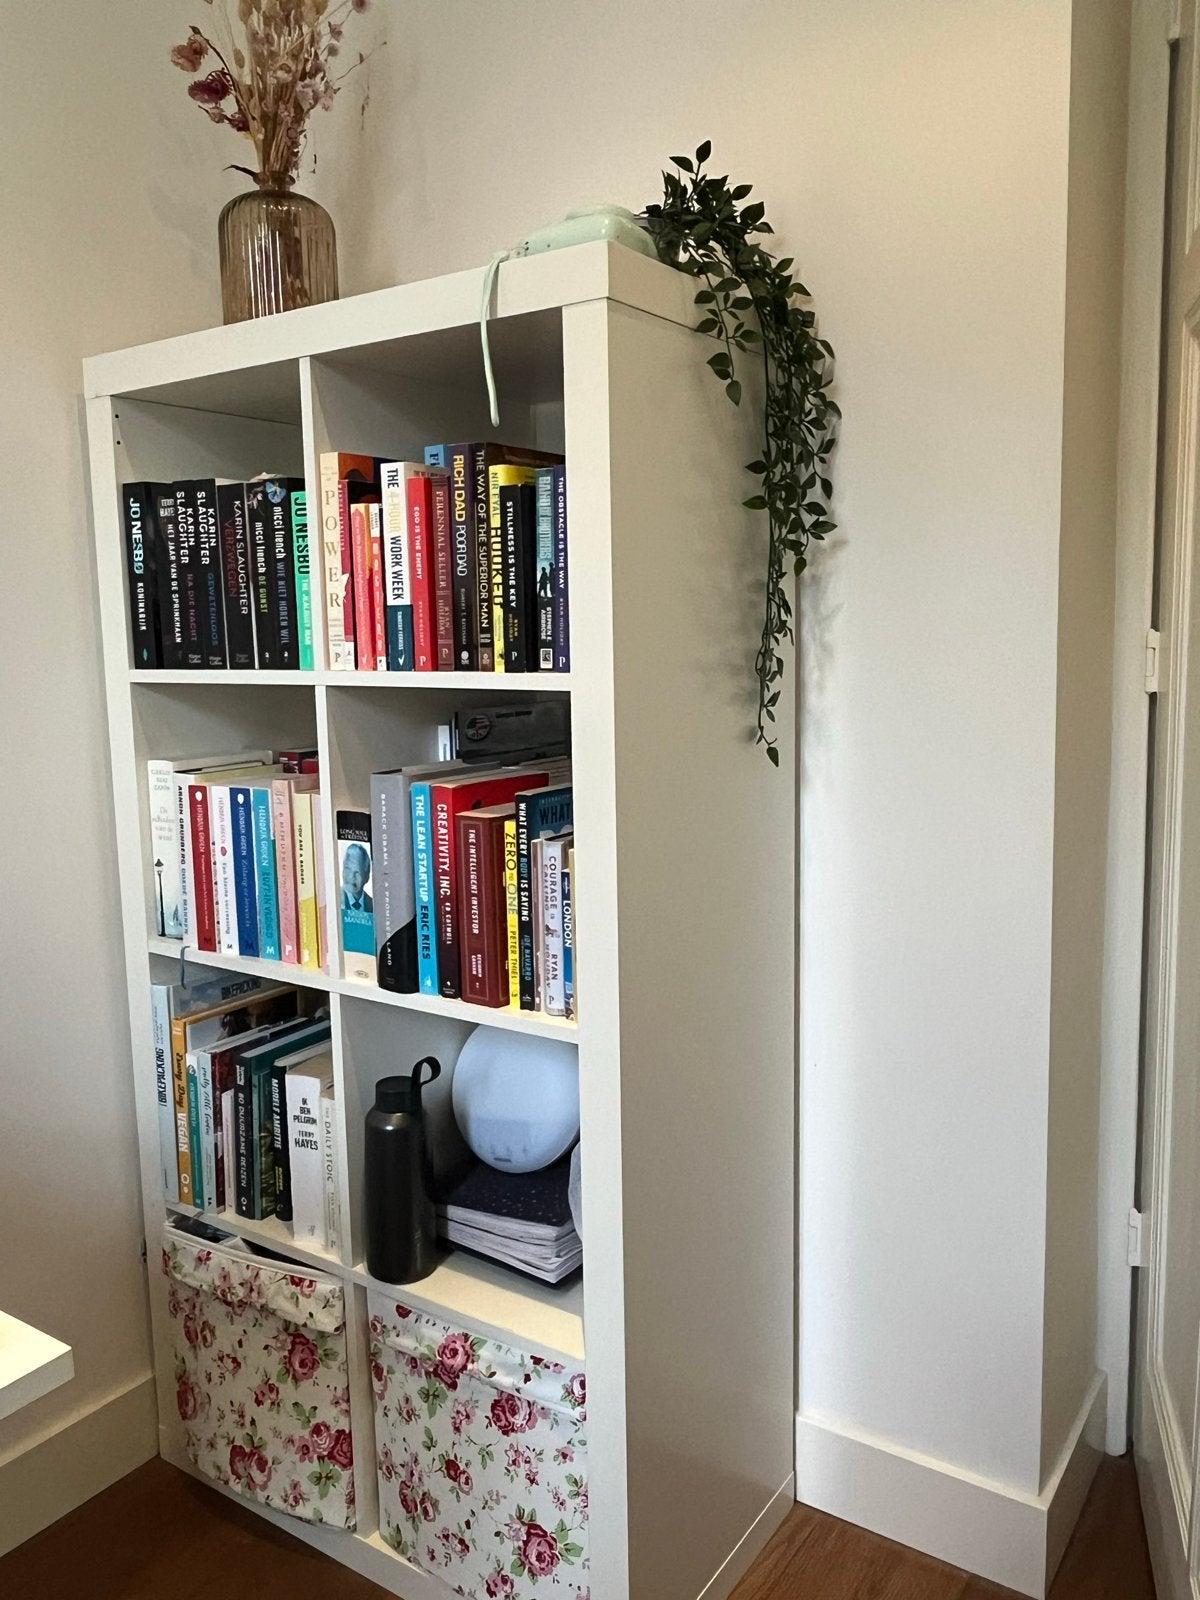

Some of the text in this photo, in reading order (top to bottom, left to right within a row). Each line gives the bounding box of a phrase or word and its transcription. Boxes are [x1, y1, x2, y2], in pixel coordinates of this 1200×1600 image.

[476, 450, 485, 471] THE
[387, 468, 399, 489] THE
[477, 473, 487, 501] WAY
[491, 472, 500, 489] NIR
[538, 477, 552, 506] BAND
[129, 497, 141, 519] JO
[273, 506, 284, 529] nicci
[413, 506, 421, 524] EGO
[453, 455, 468, 577] RICH DAD POOR DAD
[478, 502, 487, 519] OF
[176, 491, 190, 564] SLAUGHTER
[186, 508, 196, 546] KARIN
[197, 491, 210, 565] SLAUGHTER
[207, 508, 217, 547] KARIN
[255, 521, 265, 544] nicci
[415, 525, 421, 533] IS
[436, 490, 447, 588] PERENNIAL SELLER
[478, 522, 487, 542] THE
[506, 501, 514, 552] STILLNESS
[539, 517, 552, 559] BROTHERS
[168, 541, 176, 561] JAAR
[233, 501, 249, 615] KARIN SLAUGHTER
[325, 490, 341, 608] POWER
[390, 535, 403, 569] WORK
[508, 554, 515, 563] IS
[558, 541, 566, 550] IS
[479, 546, 489, 600] SUPERIOR
[558, 552, 566, 568] THE
[171, 581, 179, 591] DE
[259, 575, 266, 586] DE
[278, 581, 287, 598] NIET
[392, 569, 404, 601] WEEK
[558, 570, 566, 589] WAY
[260, 588, 269, 613] GUNST
[279, 600, 289, 626] HOREN
[172, 593, 182, 643] SPRINKHAAN
[481, 602, 490, 628] MAN
[281, 629, 290, 645] WIL
[380, 793, 388, 831] BARACK
[540, 804, 571, 825] WHAT
[179, 817, 187, 865] GRUNBERG
[436, 803, 450, 873] CREATIVITY,
[469, 845, 478, 894] INTELLIGENT
[505, 832, 518, 915] ZERO ONE
[519, 803, 529, 922] WHAT EVERY BODY IS SAYING
[415, 795, 431, 961] THE LEAN STARTUP ERIC RIES
[440, 875, 451, 899] INC.
[549, 856, 558, 910] COURAGE
[445, 902, 452, 911] ED
[471, 896, 479, 934] INVESTOR
[562, 900, 573, 948] LONDON
[510, 930, 519, 981] PETER THIEL
[551, 953, 559, 980] RYAN
[176, 1083, 186, 1108] Day
[293, 1115, 318, 1125] PELGRIM
[300, 1106, 312, 1116] BEN
[178, 1112, 191, 1153] VEGAN
[238, 1106, 246, 1154] DUURZAME
[294, 1138, 319, 1151] HAYES
[325, 1152, 334, 1184] STOIC
